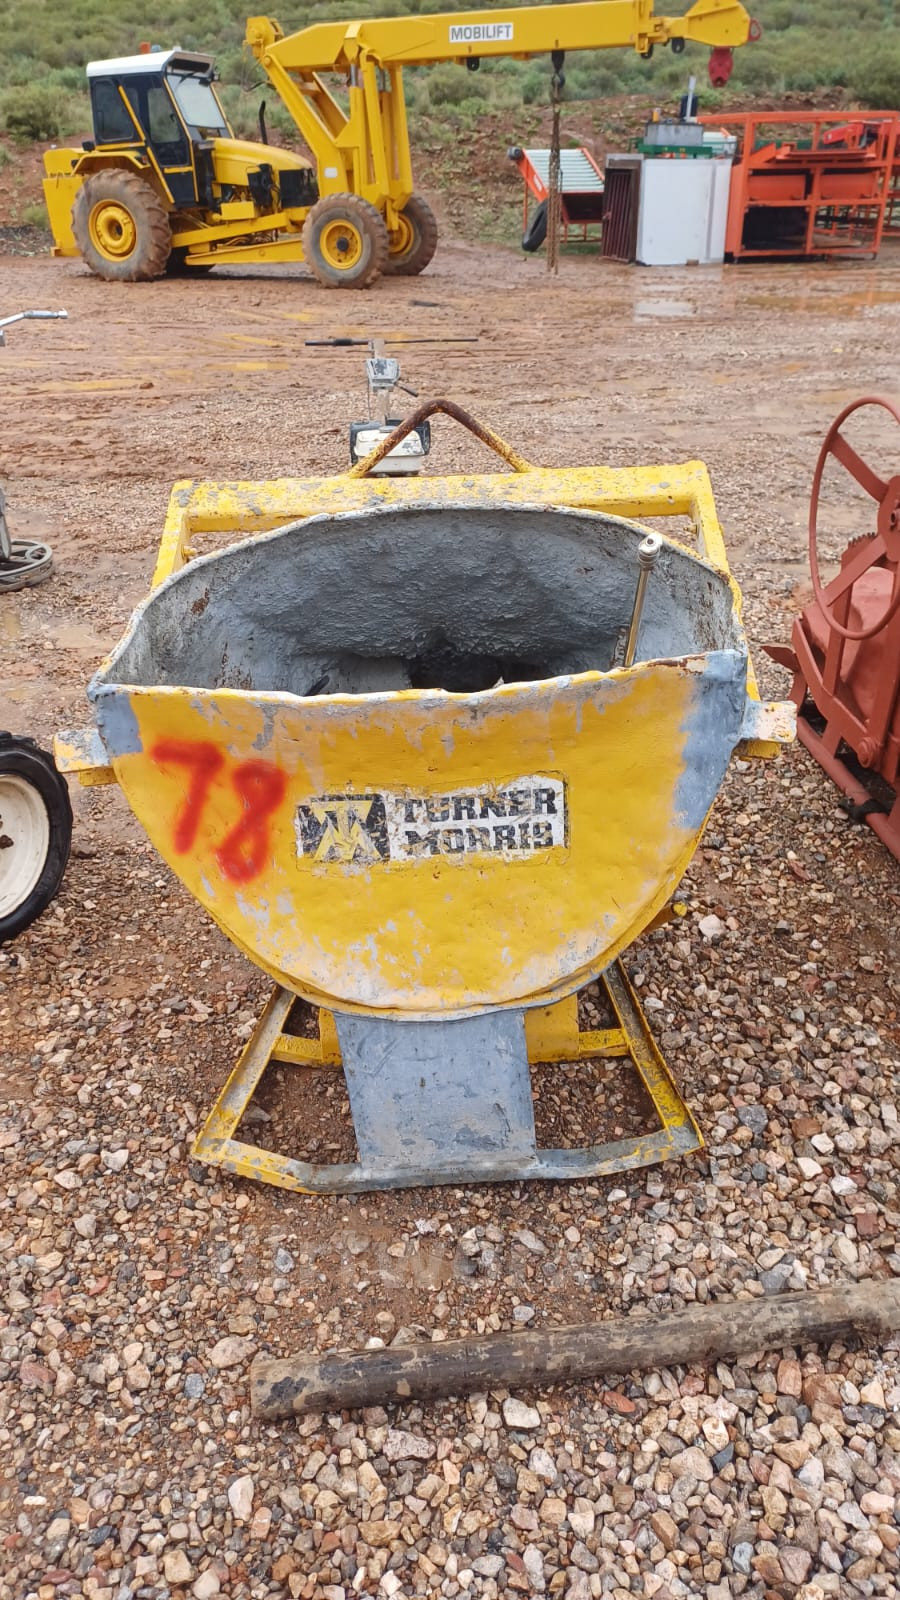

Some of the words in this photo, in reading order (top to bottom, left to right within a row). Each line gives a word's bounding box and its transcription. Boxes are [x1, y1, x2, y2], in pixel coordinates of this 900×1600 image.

[450, 24, 512, 41] MOBILIFT
[150, 738, 287, 883] 78
[395, 788, 558, 824] TURNER
[404, 821, 555, 857] MORRIS
